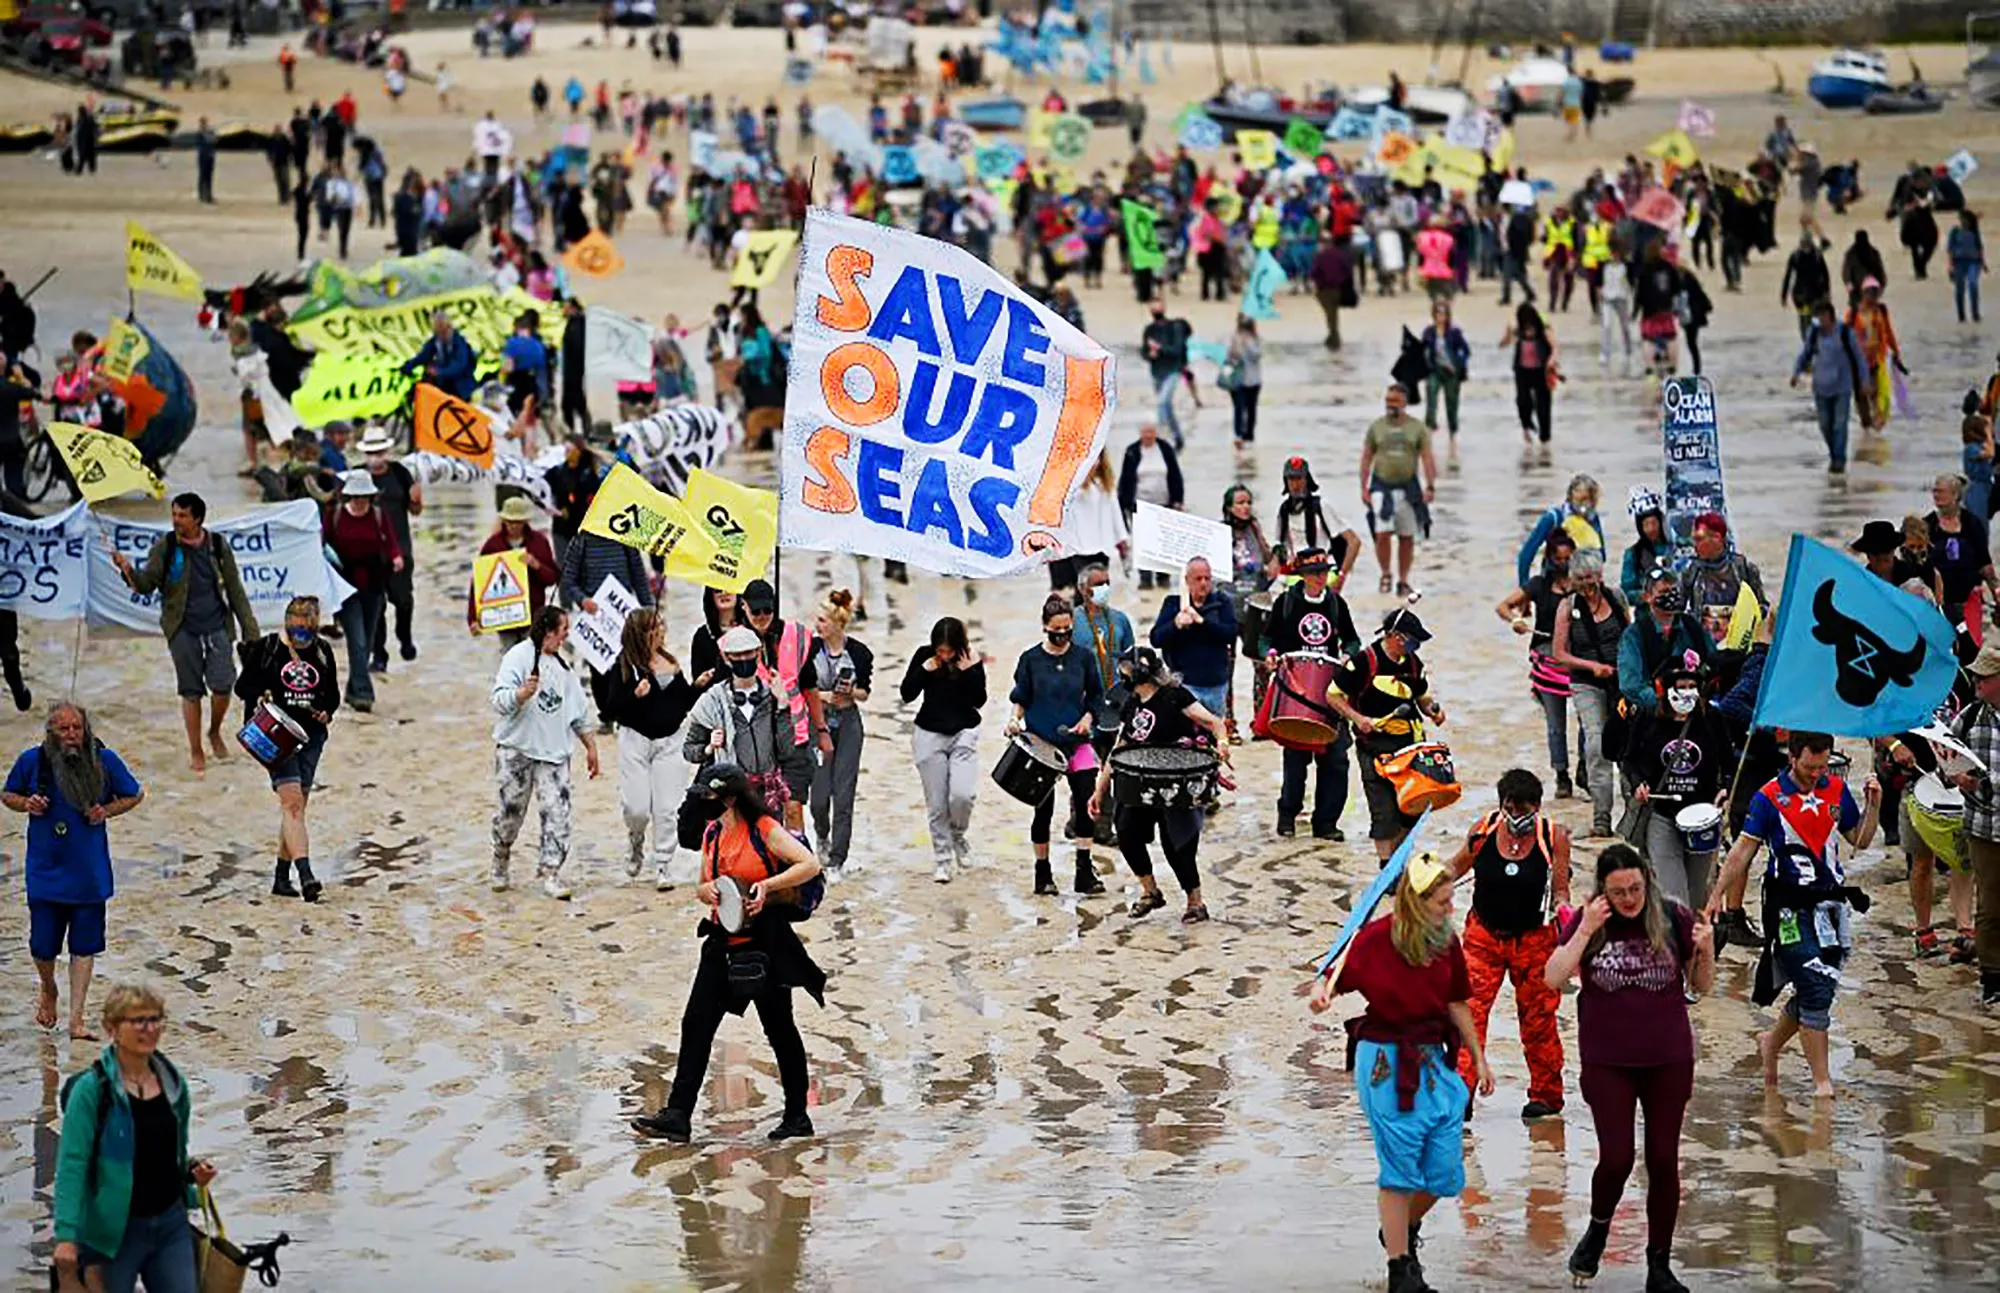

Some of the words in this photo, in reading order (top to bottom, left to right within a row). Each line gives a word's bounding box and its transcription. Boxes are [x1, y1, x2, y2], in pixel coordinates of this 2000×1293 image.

[815, 244, 1052, 388] SAVE
[820, 341, 1038, 471] OUR
[1664, 381, 1712, 411] OCEAN
[1673, 407, 1714, 423] ALARM
[801, 425, 1021, 559] SEAS
[608, 503, 641, 535] G7
[706, 504, 744, 537] G7
[575, 618, 616, 662] HISTORY
